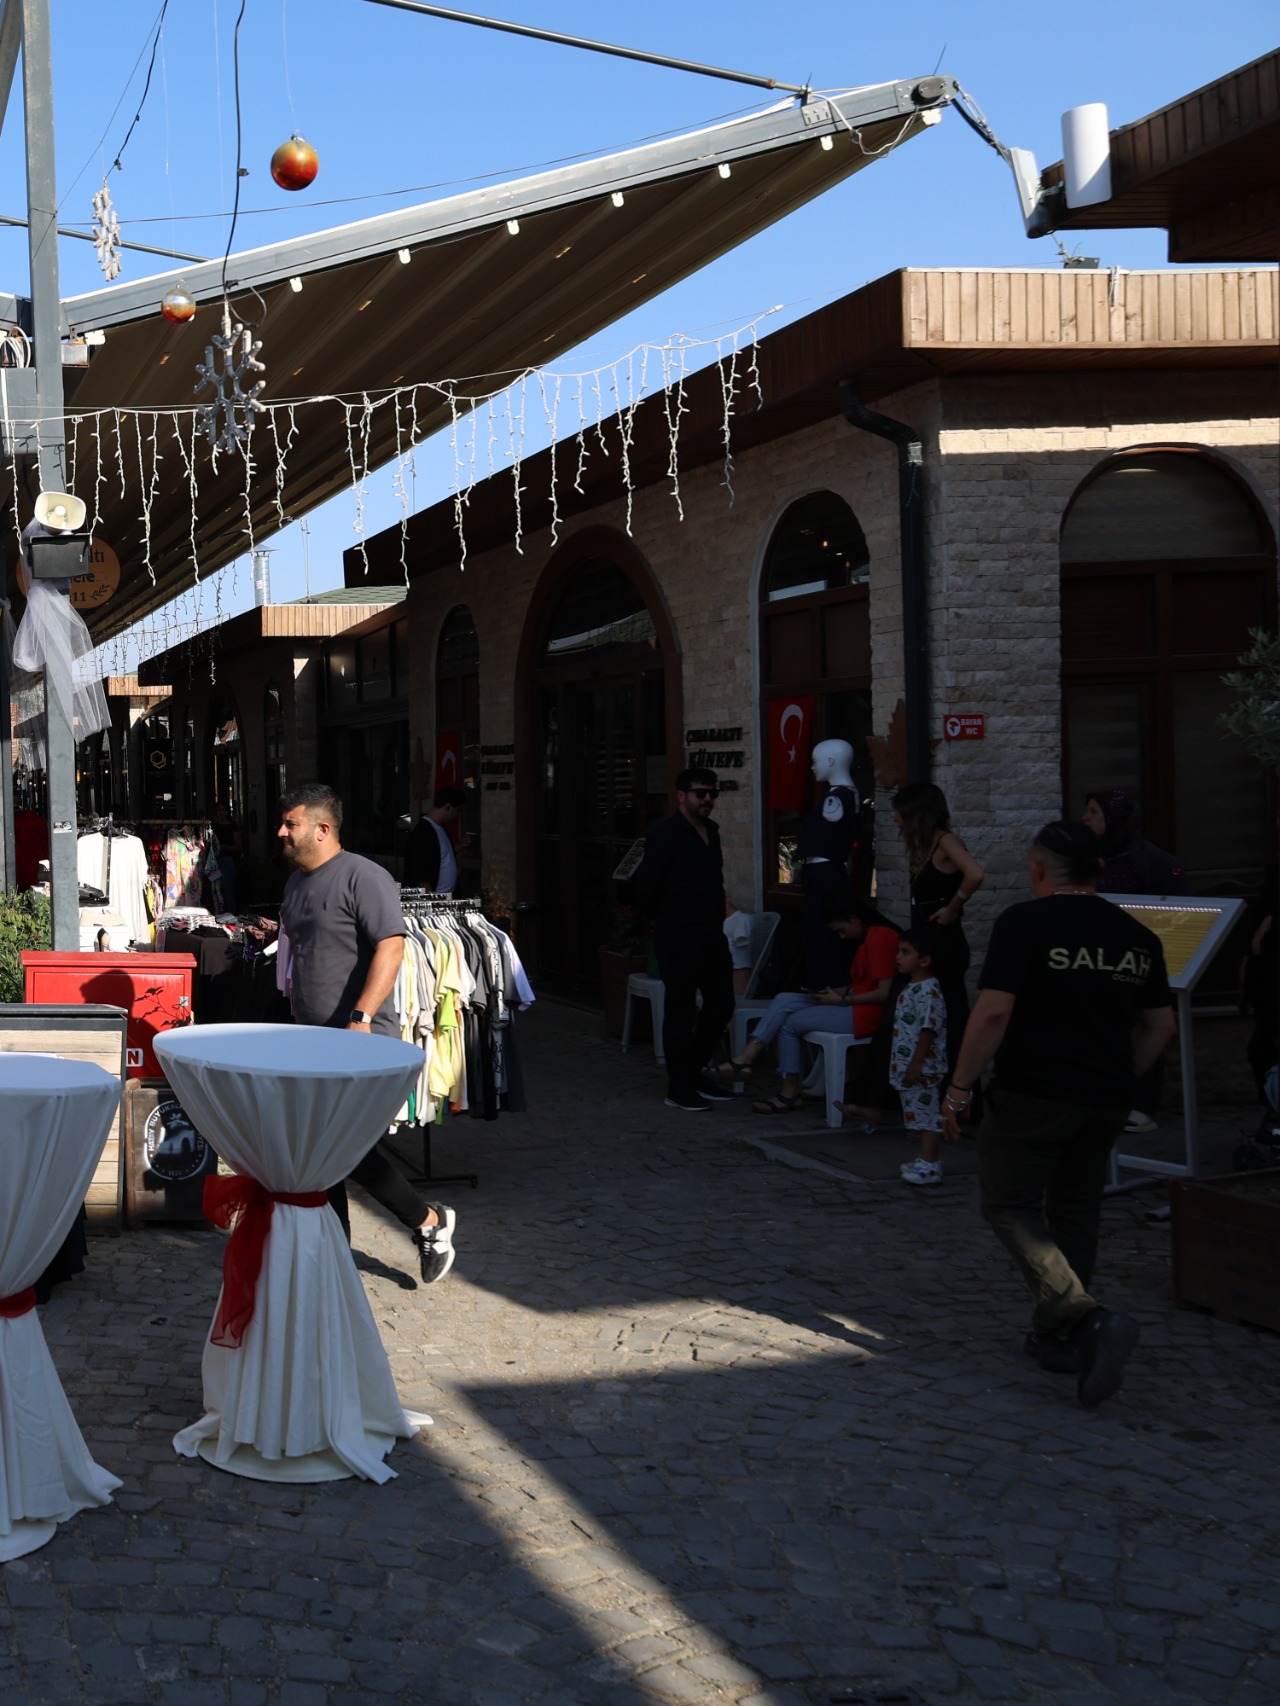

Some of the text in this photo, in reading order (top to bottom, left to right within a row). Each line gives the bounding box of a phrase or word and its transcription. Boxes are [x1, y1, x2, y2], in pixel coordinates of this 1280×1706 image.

[960, 718, 983, 726] BAYAN
[965, 727, 978, 735] WC
[1047, 947, 1152, 977] SALAH
